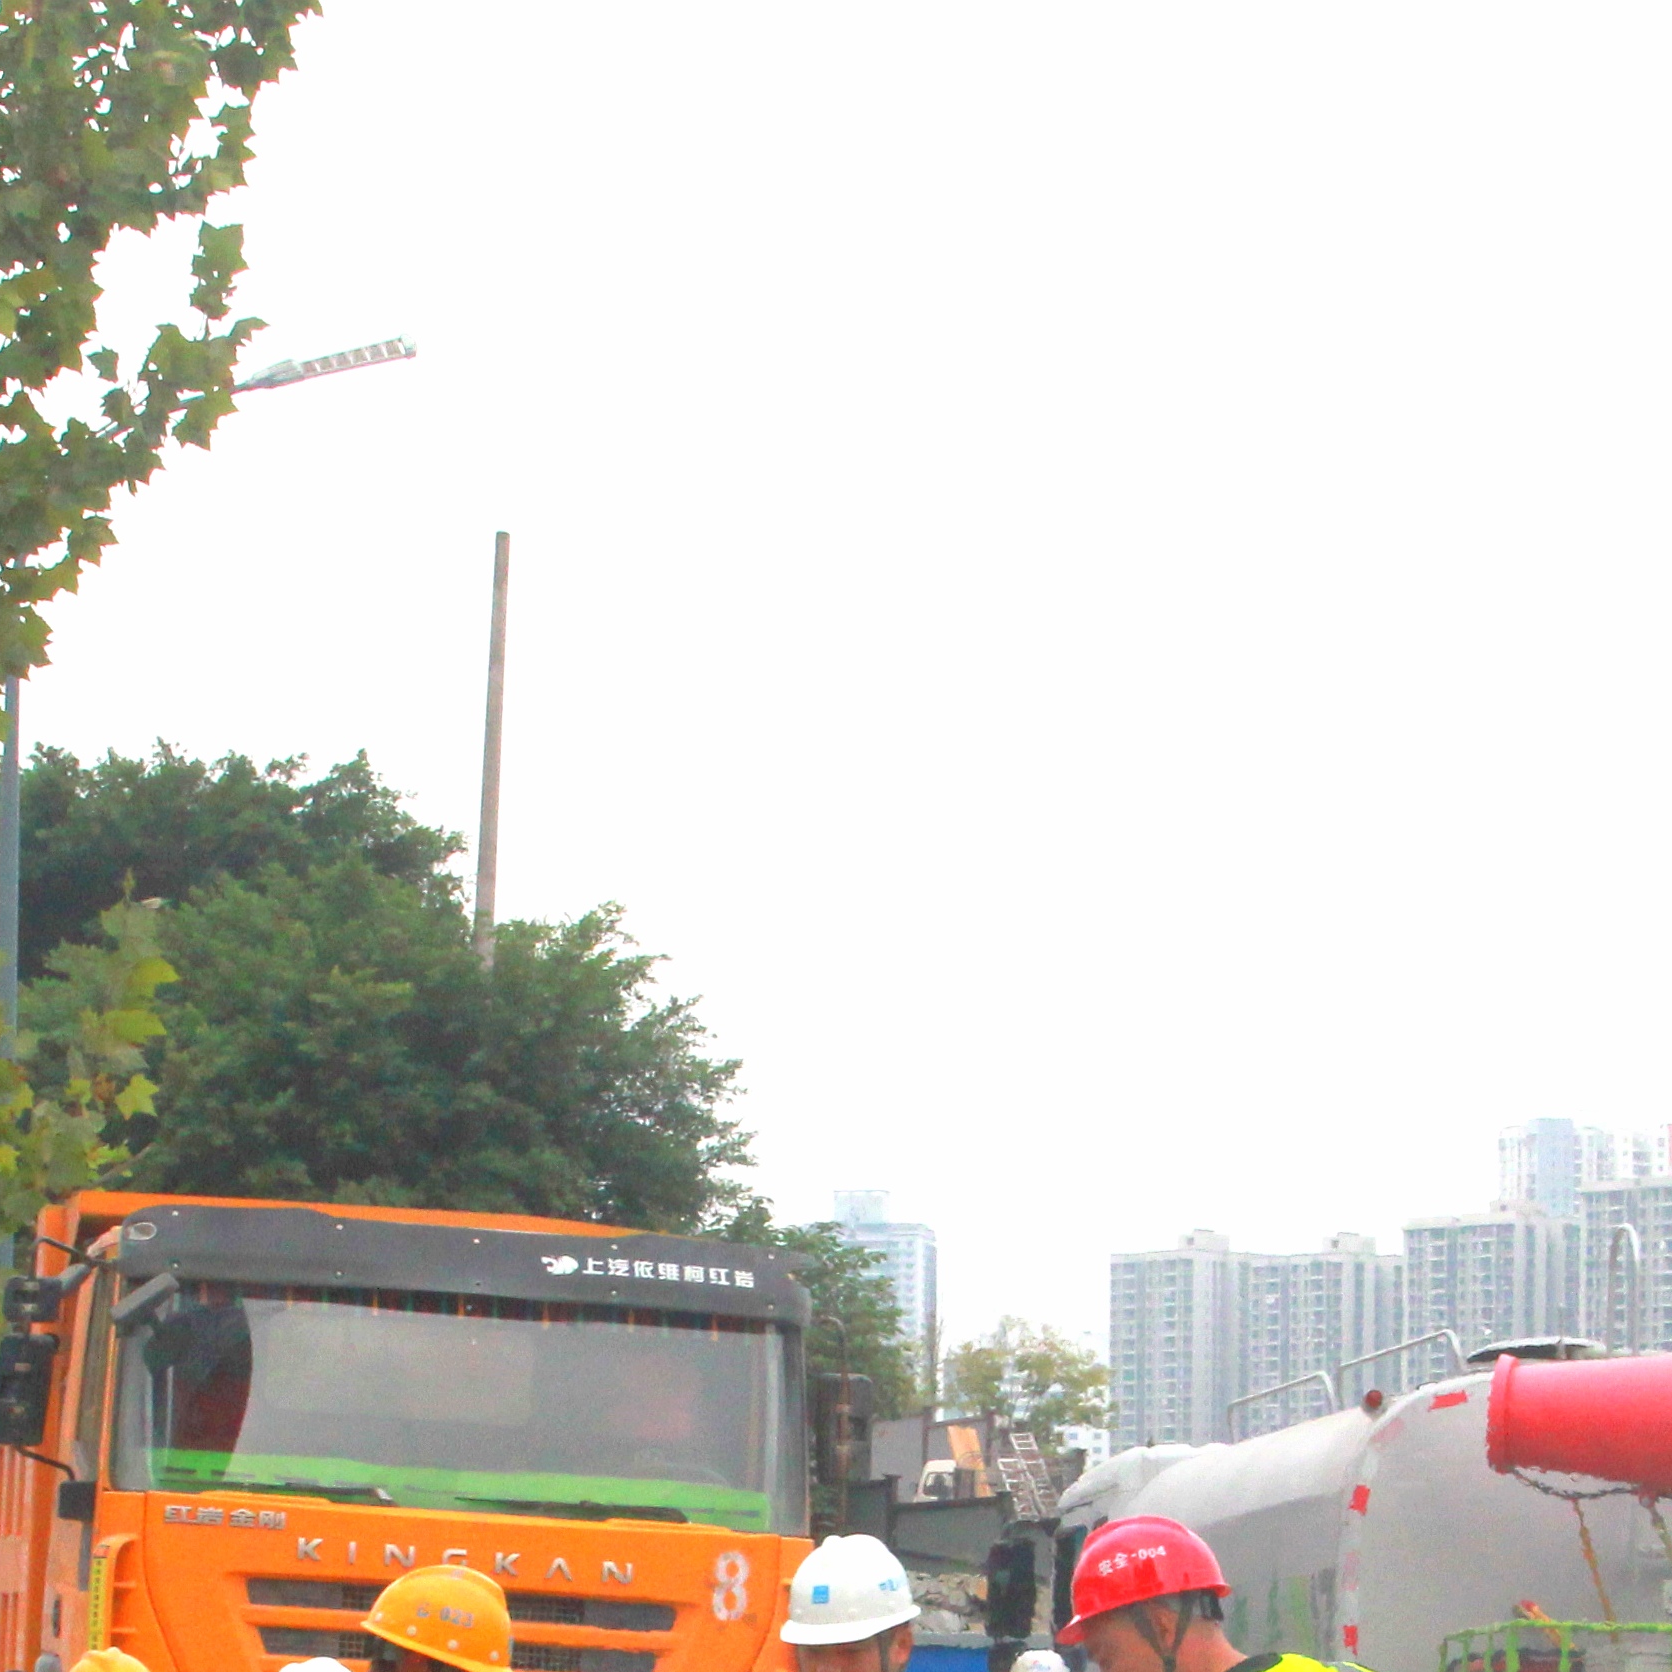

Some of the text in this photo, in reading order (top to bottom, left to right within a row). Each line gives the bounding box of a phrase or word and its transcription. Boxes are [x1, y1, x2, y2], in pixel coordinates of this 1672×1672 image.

[582, 1257, 755, 1289] 上汽依维柯红岩
[164, 1505, 288, 1530] 红岩金刚
[296, 1536, 634, 1586] KINGKAN
[711, 1550, 750, 1622] 8
